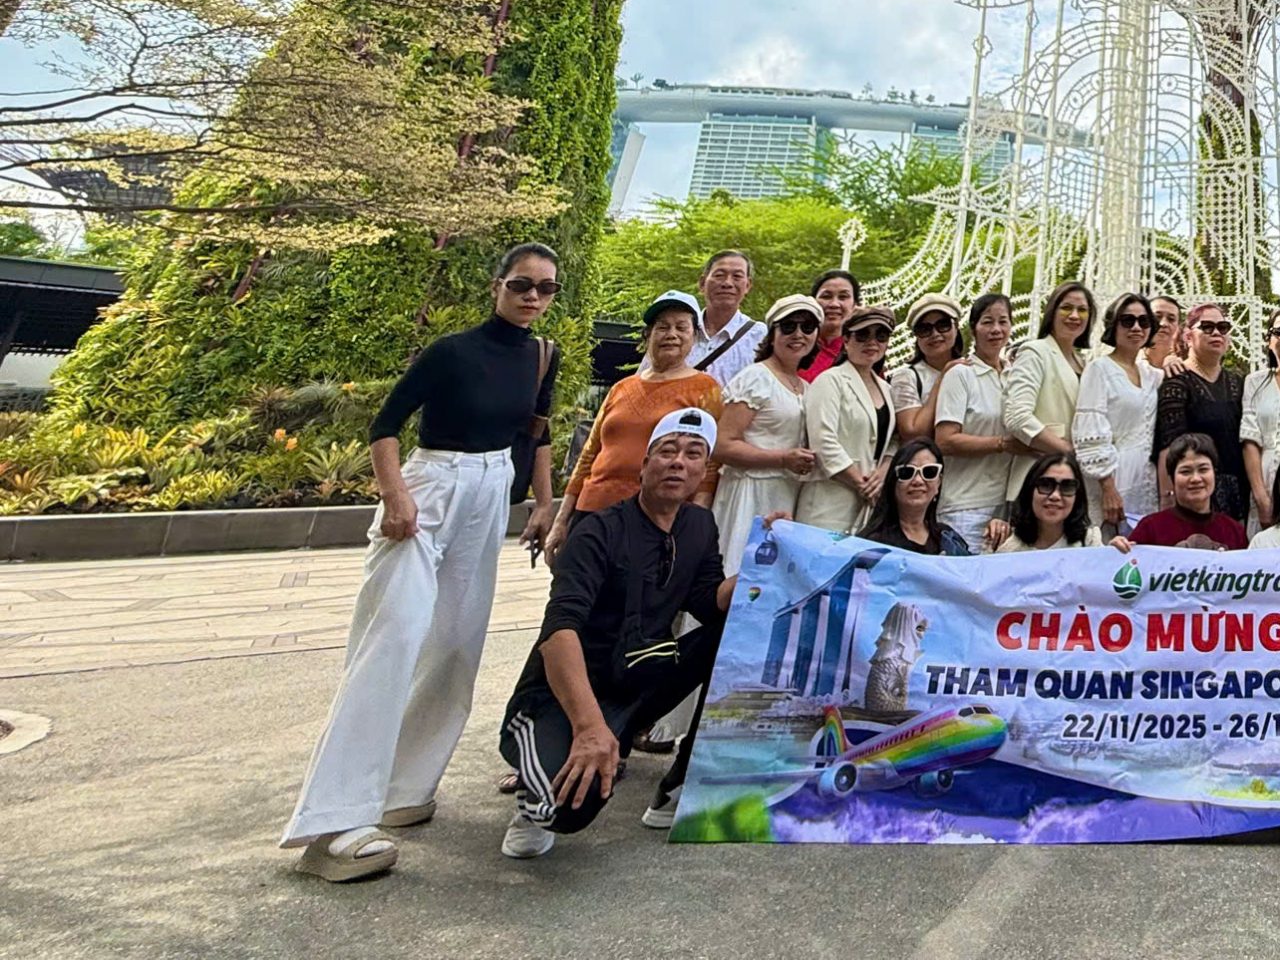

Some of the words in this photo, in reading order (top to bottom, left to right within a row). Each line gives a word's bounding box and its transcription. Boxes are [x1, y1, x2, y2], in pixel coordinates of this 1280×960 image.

[996, 605, 1133, 652] CHÀO
[926, 665, 1028, 697] THAM
[1034, 669, 1134, 700] QUAN
[1062, 712, 1206, 742] 22/11/2025
